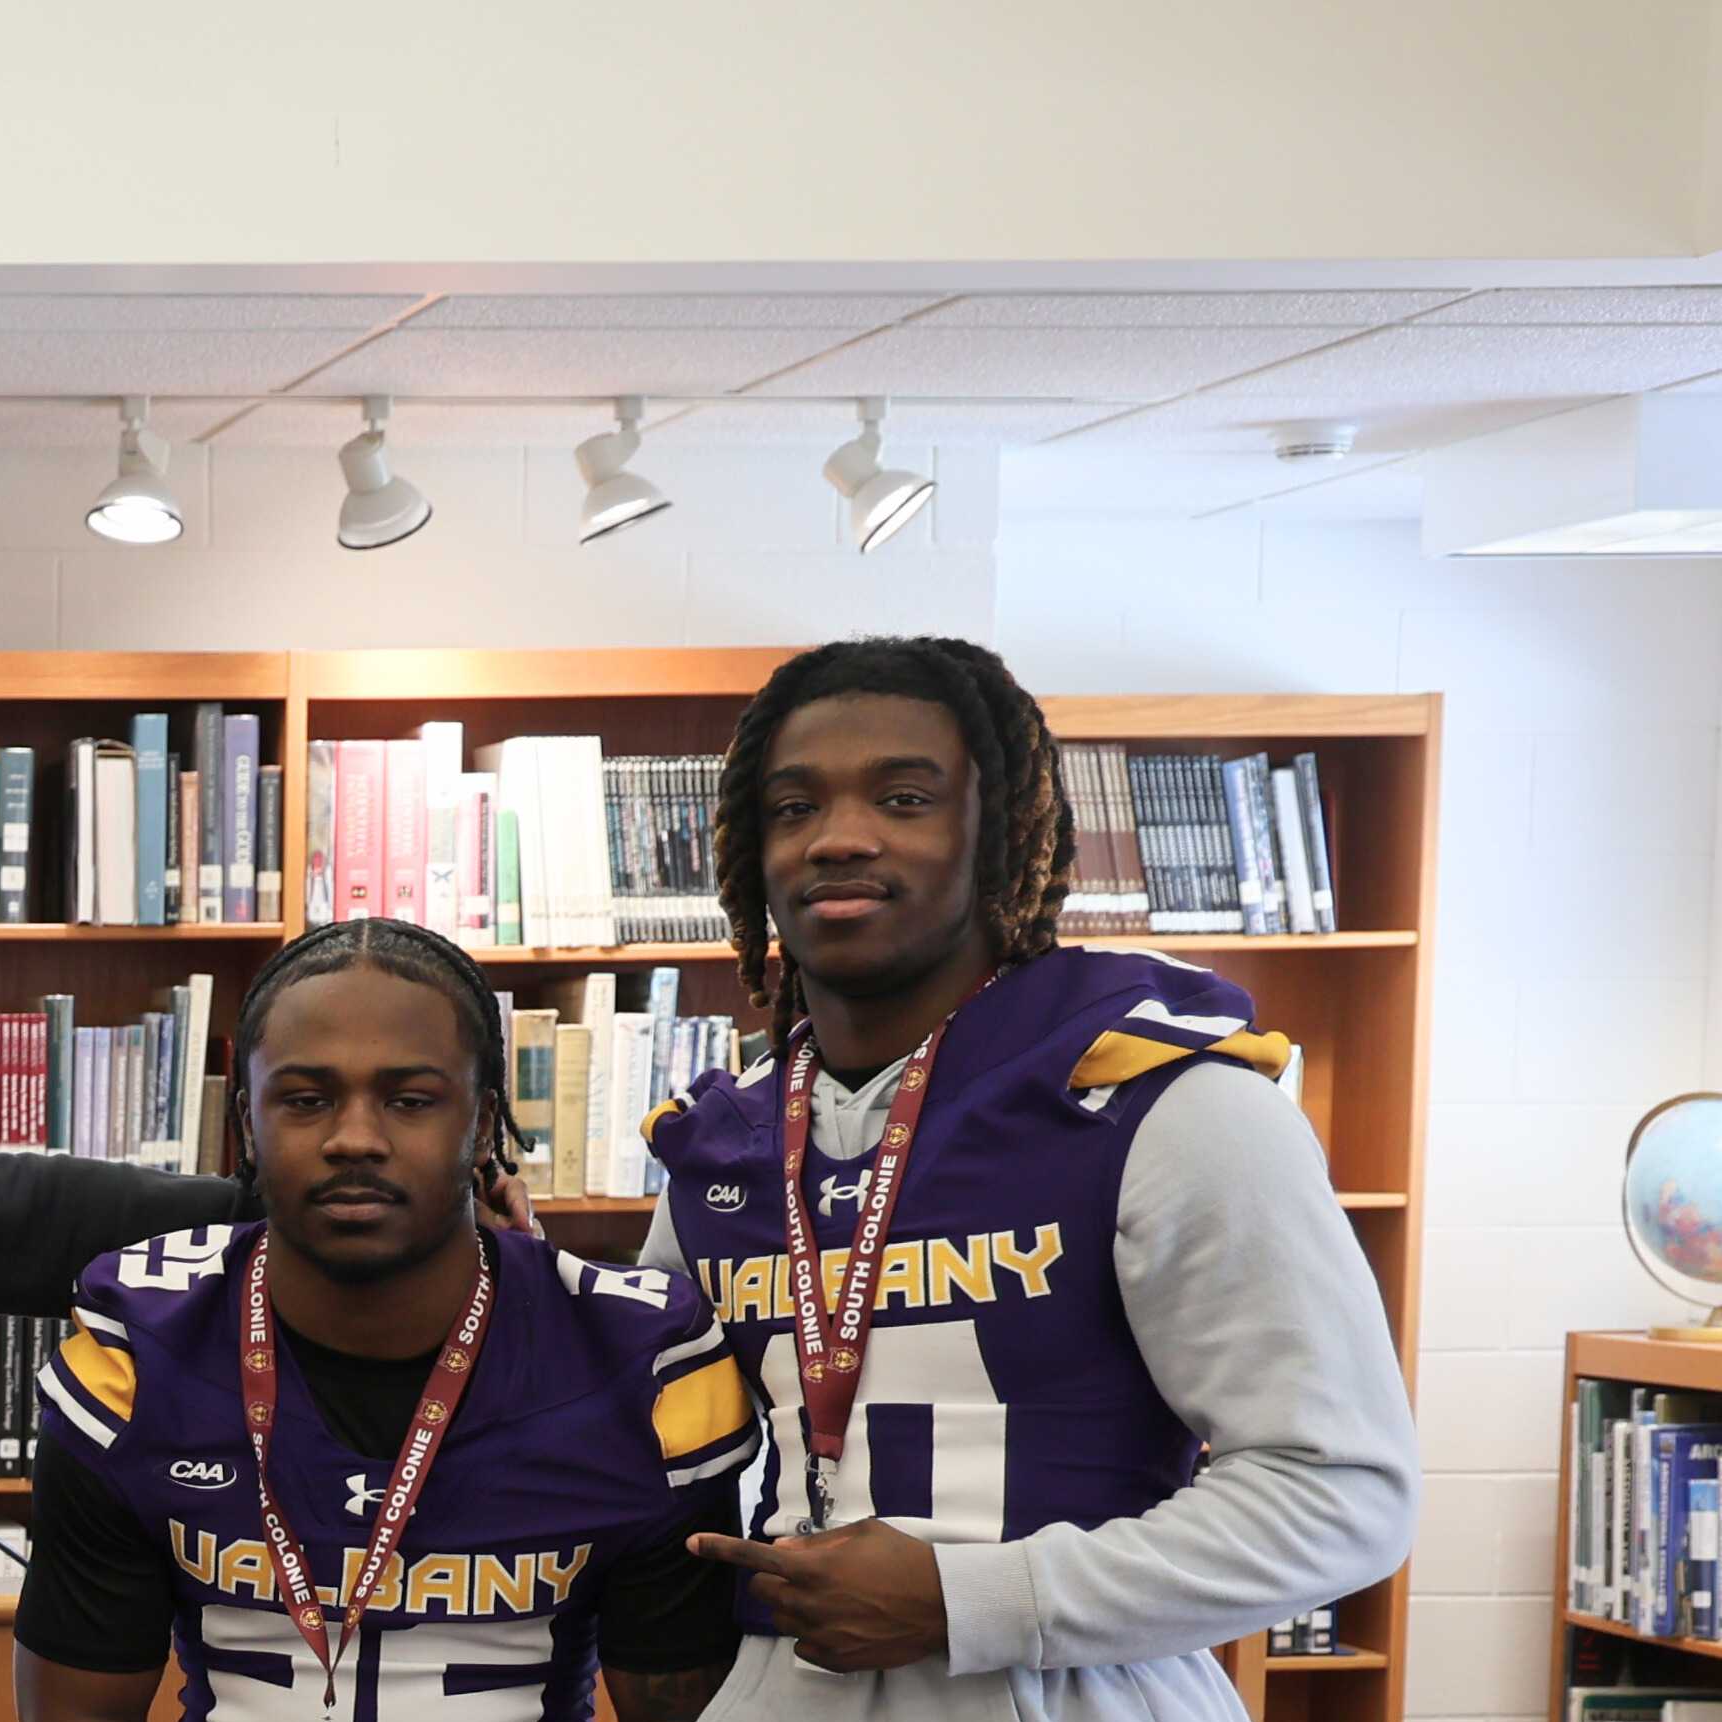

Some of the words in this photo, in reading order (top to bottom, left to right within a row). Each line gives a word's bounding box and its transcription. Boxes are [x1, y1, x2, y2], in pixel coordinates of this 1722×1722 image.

[706, 1184, 741, 1204] CAA
[784, 1179, 807, 1255] SOUTH
[796, 1258, 824, 1356] COLONIE
[840, 1261, 871, 1341] SOUTH
[862, 1154, 898, 1255] COLONIE
[250, 1253, 267, 1344] COLONIE
[458, 1275, 493, 1346] SOUTH
[170, 1460, 224, 1481] CAA
[356, 1526, 394, 1600] SOUTH
[386, 1427, 434, 1523] COLONIE
[264, 1511, 312, 1605] COLONIE
